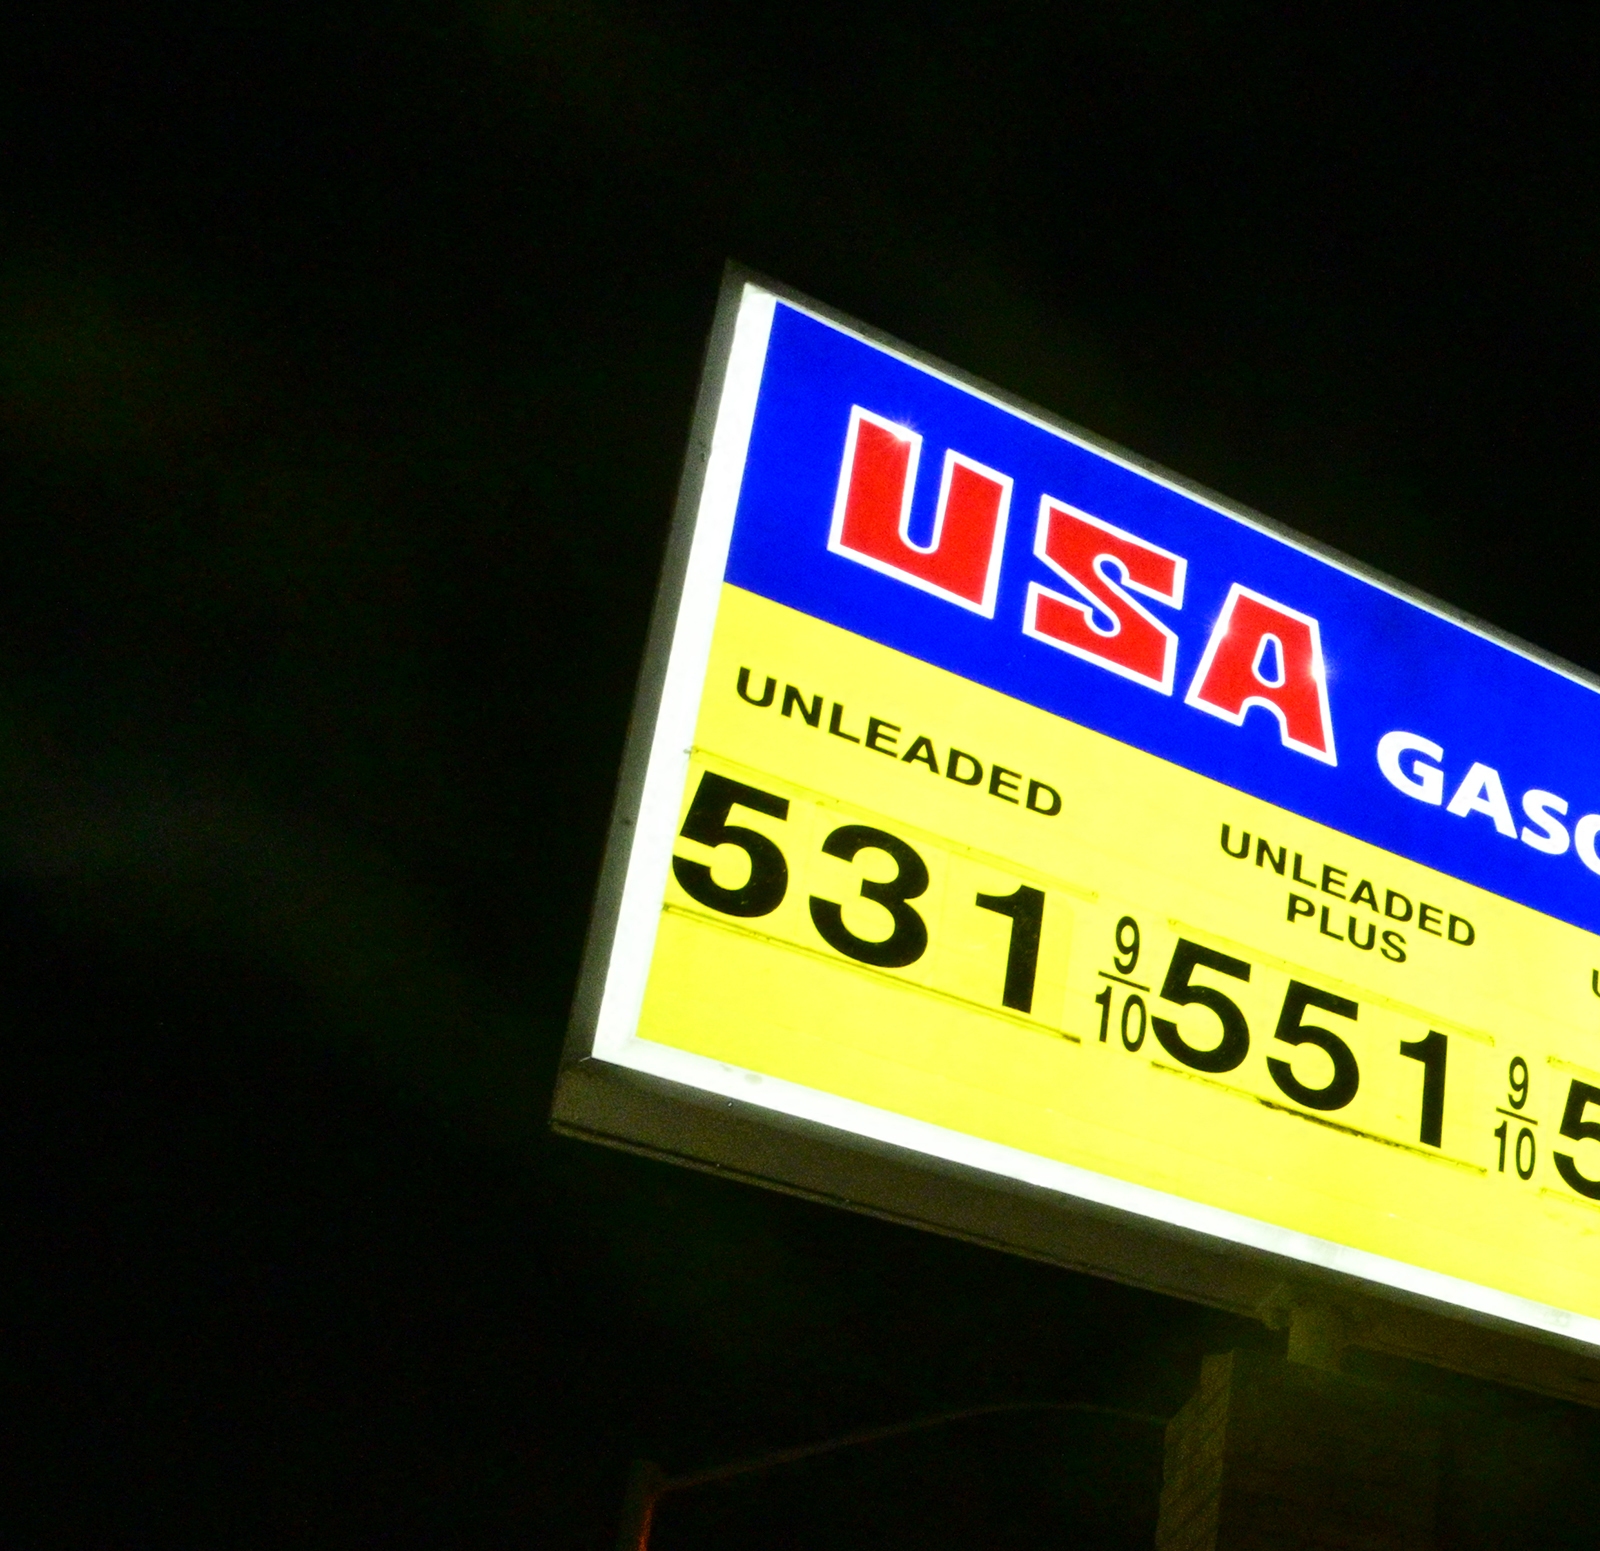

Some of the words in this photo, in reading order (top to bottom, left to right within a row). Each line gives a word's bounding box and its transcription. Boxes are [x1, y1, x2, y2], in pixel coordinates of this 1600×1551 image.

[827, 404, 1337, 767] USA
[738, 668, 1061, 816] UNLEADED
[673, 771, 1045, 1013] 531
[1220, 825, 1475, 948] UNLEADED
[1287, 895, 1408, 964] PLUS
[1152, 939, 1447, 1147] 551
